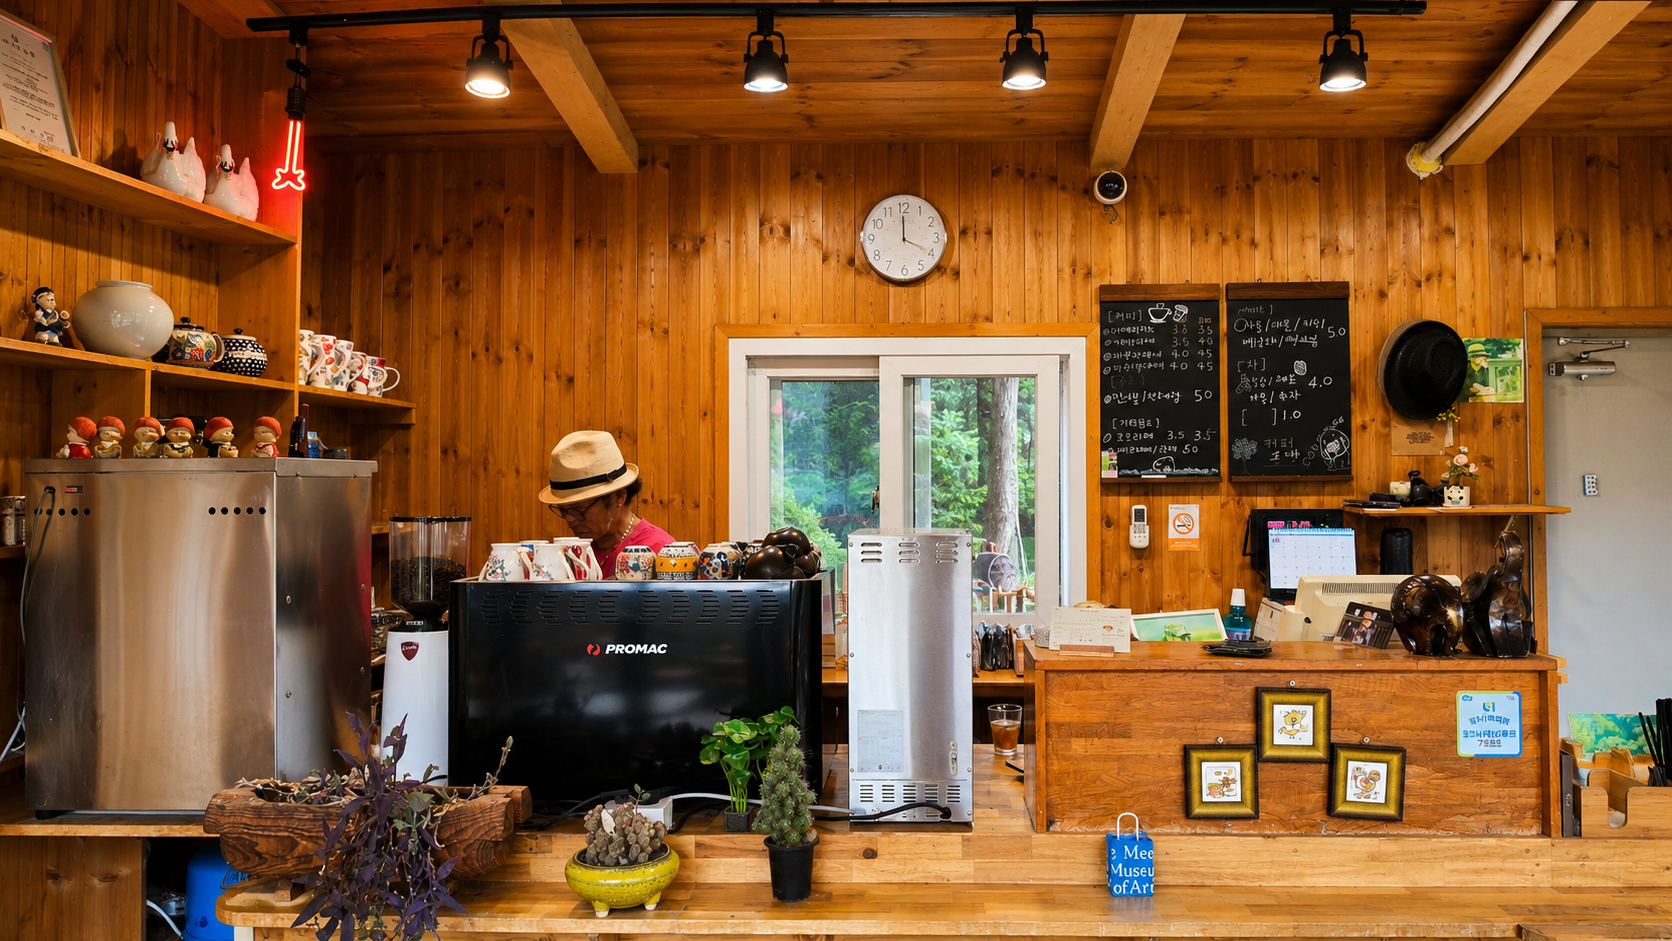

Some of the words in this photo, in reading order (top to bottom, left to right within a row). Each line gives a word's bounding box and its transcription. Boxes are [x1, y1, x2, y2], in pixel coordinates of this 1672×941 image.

[883, 206, 892, 218] 11
[898, 202, 910, 214] 12
[872, 218, 884, 230] 10
[927, 215, 935, 228] 2
[868, 233, 875, 245] 9
[932, 232, 940, 244] 3
[873, 249, 881, 261] 8
[927, 248, 935, 259] 4
[885, 260, 892, 272] 7
[900, 264, 909, 277] 6
[917, 259, 925, 272] 5
[1308, 376, 1333, 389] 4.0
[1282, 409, 1302, 421] 1.0
[605, 643, 668, 655] PROMAC
[1113, 879, 1129, 895] of
